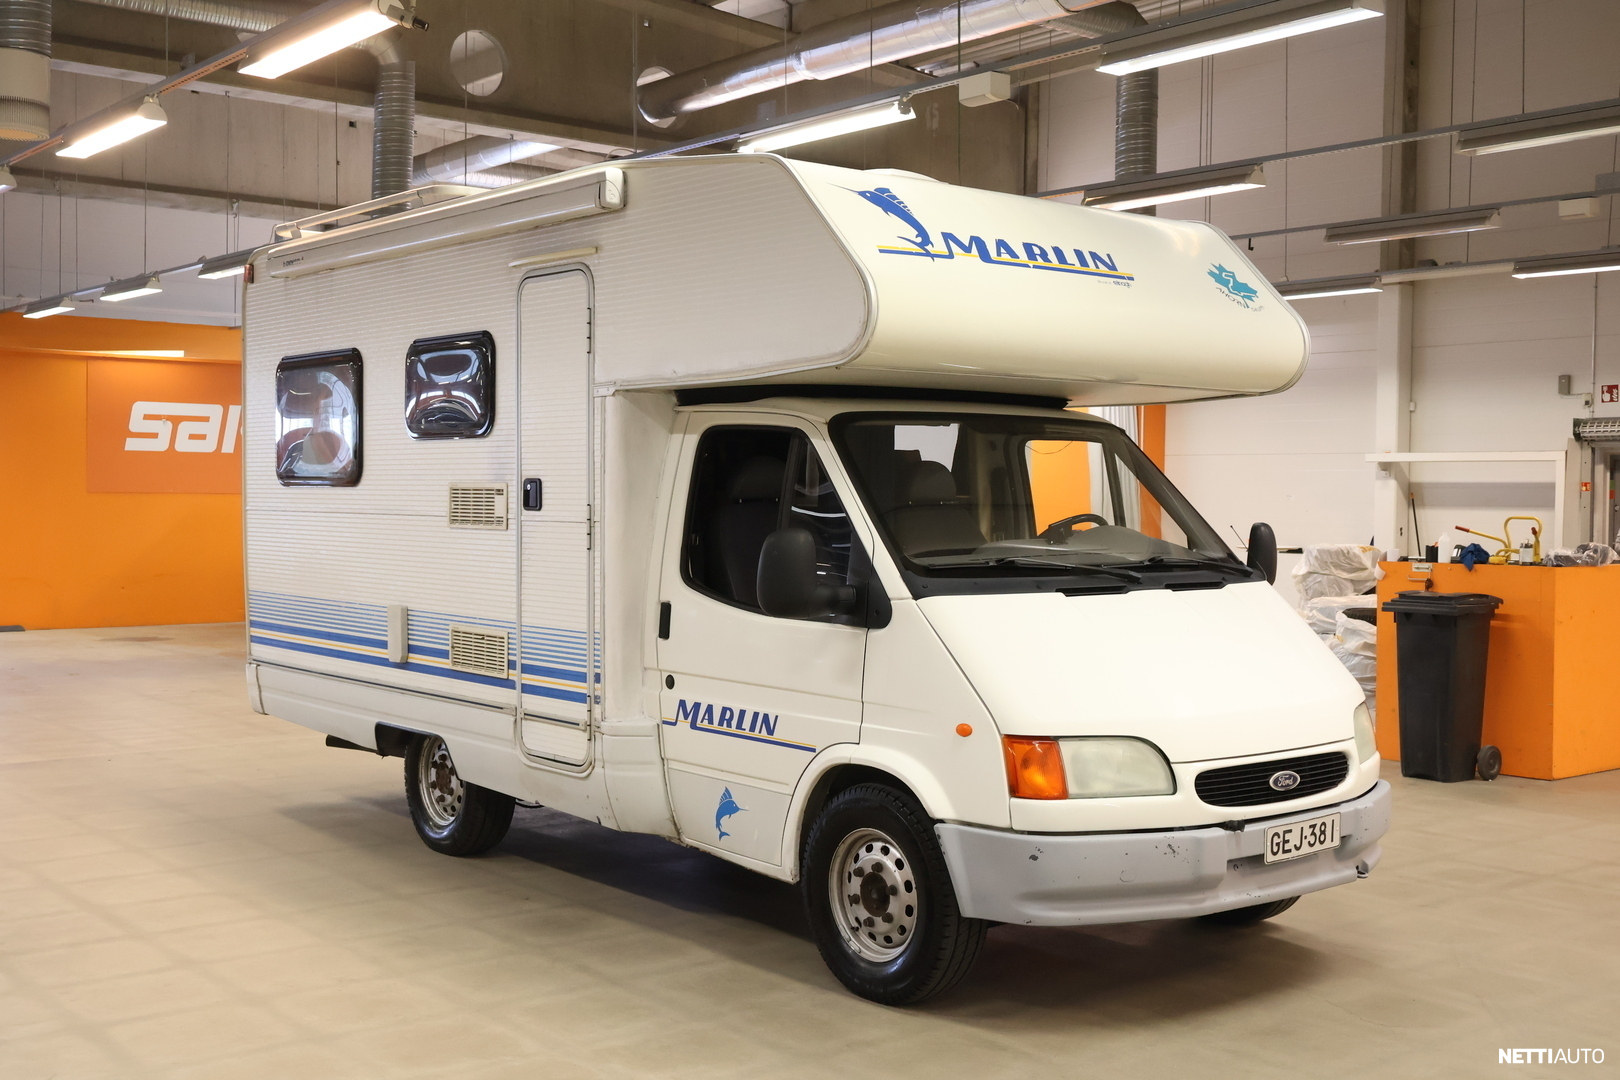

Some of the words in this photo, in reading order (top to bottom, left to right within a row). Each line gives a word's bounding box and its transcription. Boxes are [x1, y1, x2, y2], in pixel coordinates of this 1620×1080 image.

[941, 231, 1118, 272] MARLIN
[674, 698, 779, 737] MARLIN
[1277, 774, 1295, 788] Ford
[1270, 818, 1335, 856] GEJ-381
